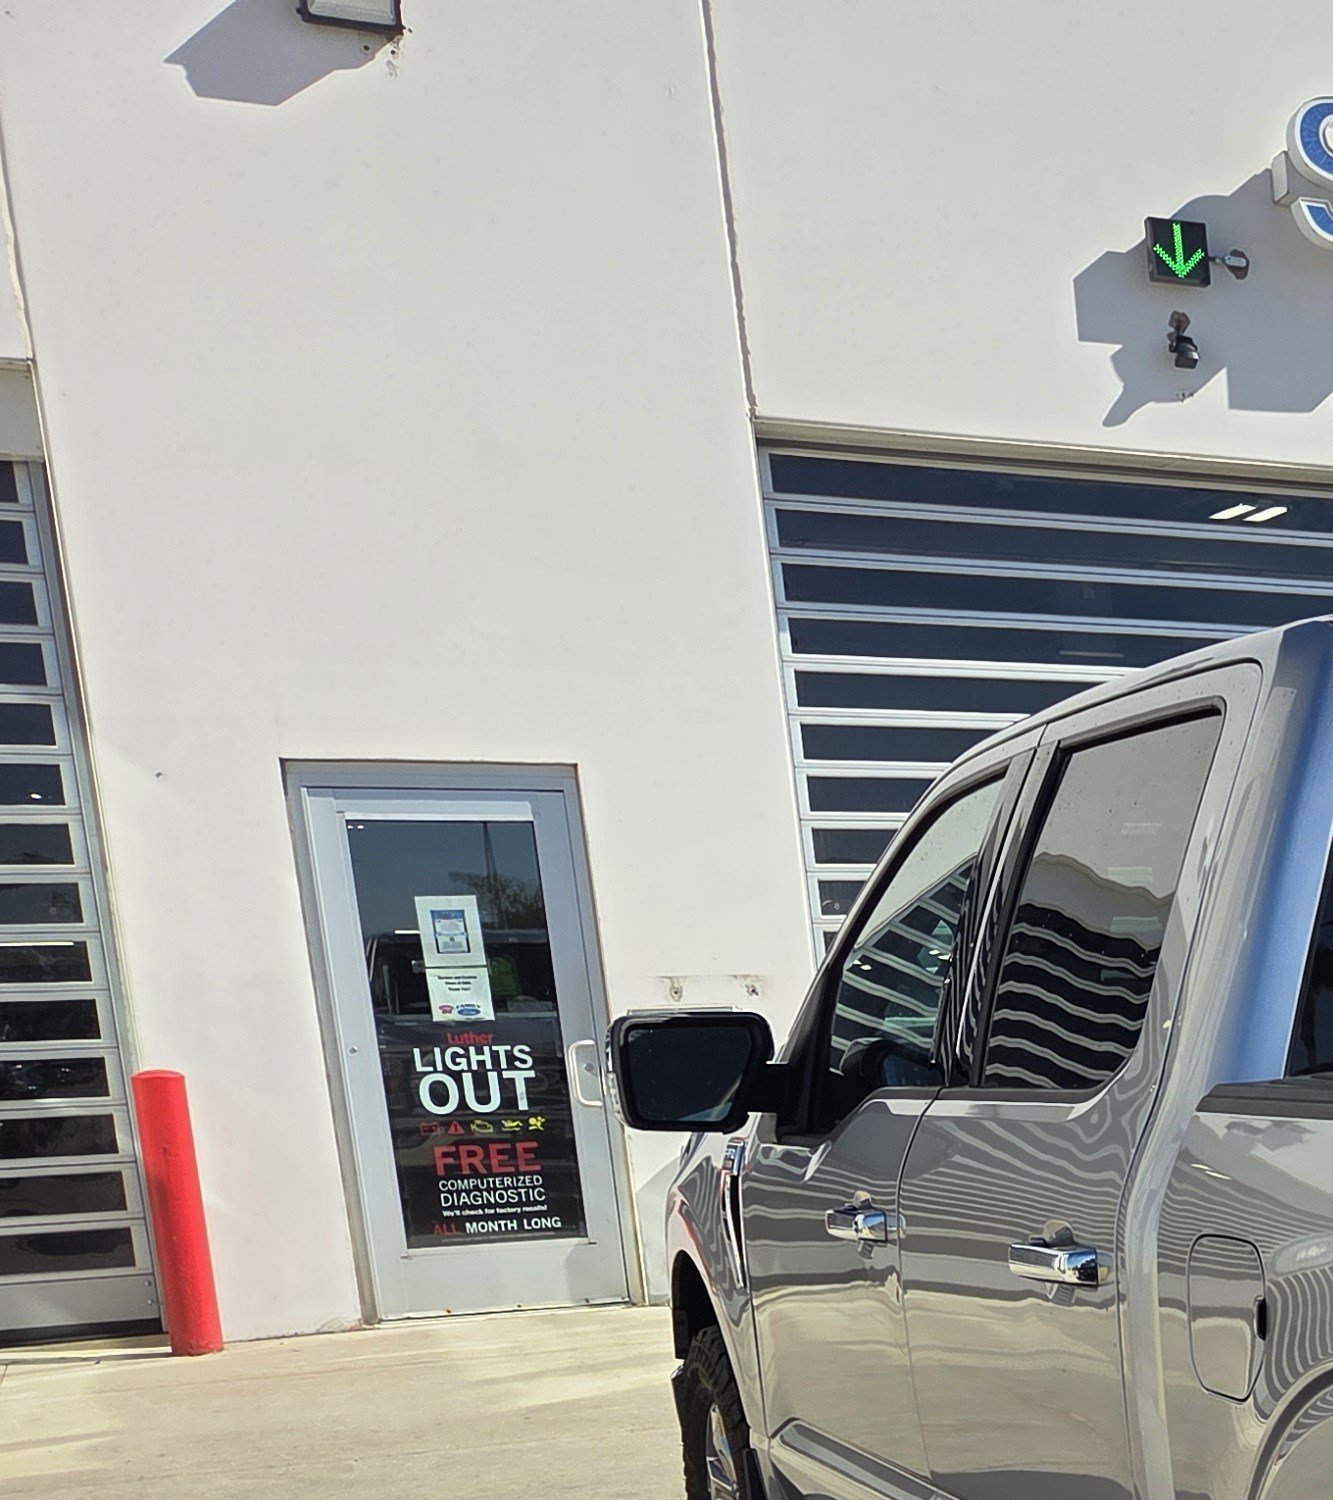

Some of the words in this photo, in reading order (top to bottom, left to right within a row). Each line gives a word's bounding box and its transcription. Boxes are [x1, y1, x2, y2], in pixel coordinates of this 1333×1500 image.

[446, 1031, 493, 1045] Luther
[413, 1045, 533, 1072] LIGHTS
[419, 1070, 536, 1115] OUT
[433, 1141, 541, 1176] FREE
[438, 1175, 543, 1191] COMPUTERIZED
[440, 1188, 546, 1207] DIAGNOSTIC
[434, 1222, 458, 1236] ALL
[465, 1219, 518, 1234] MONTH
[523, 1216, 562, 1230] LONG
